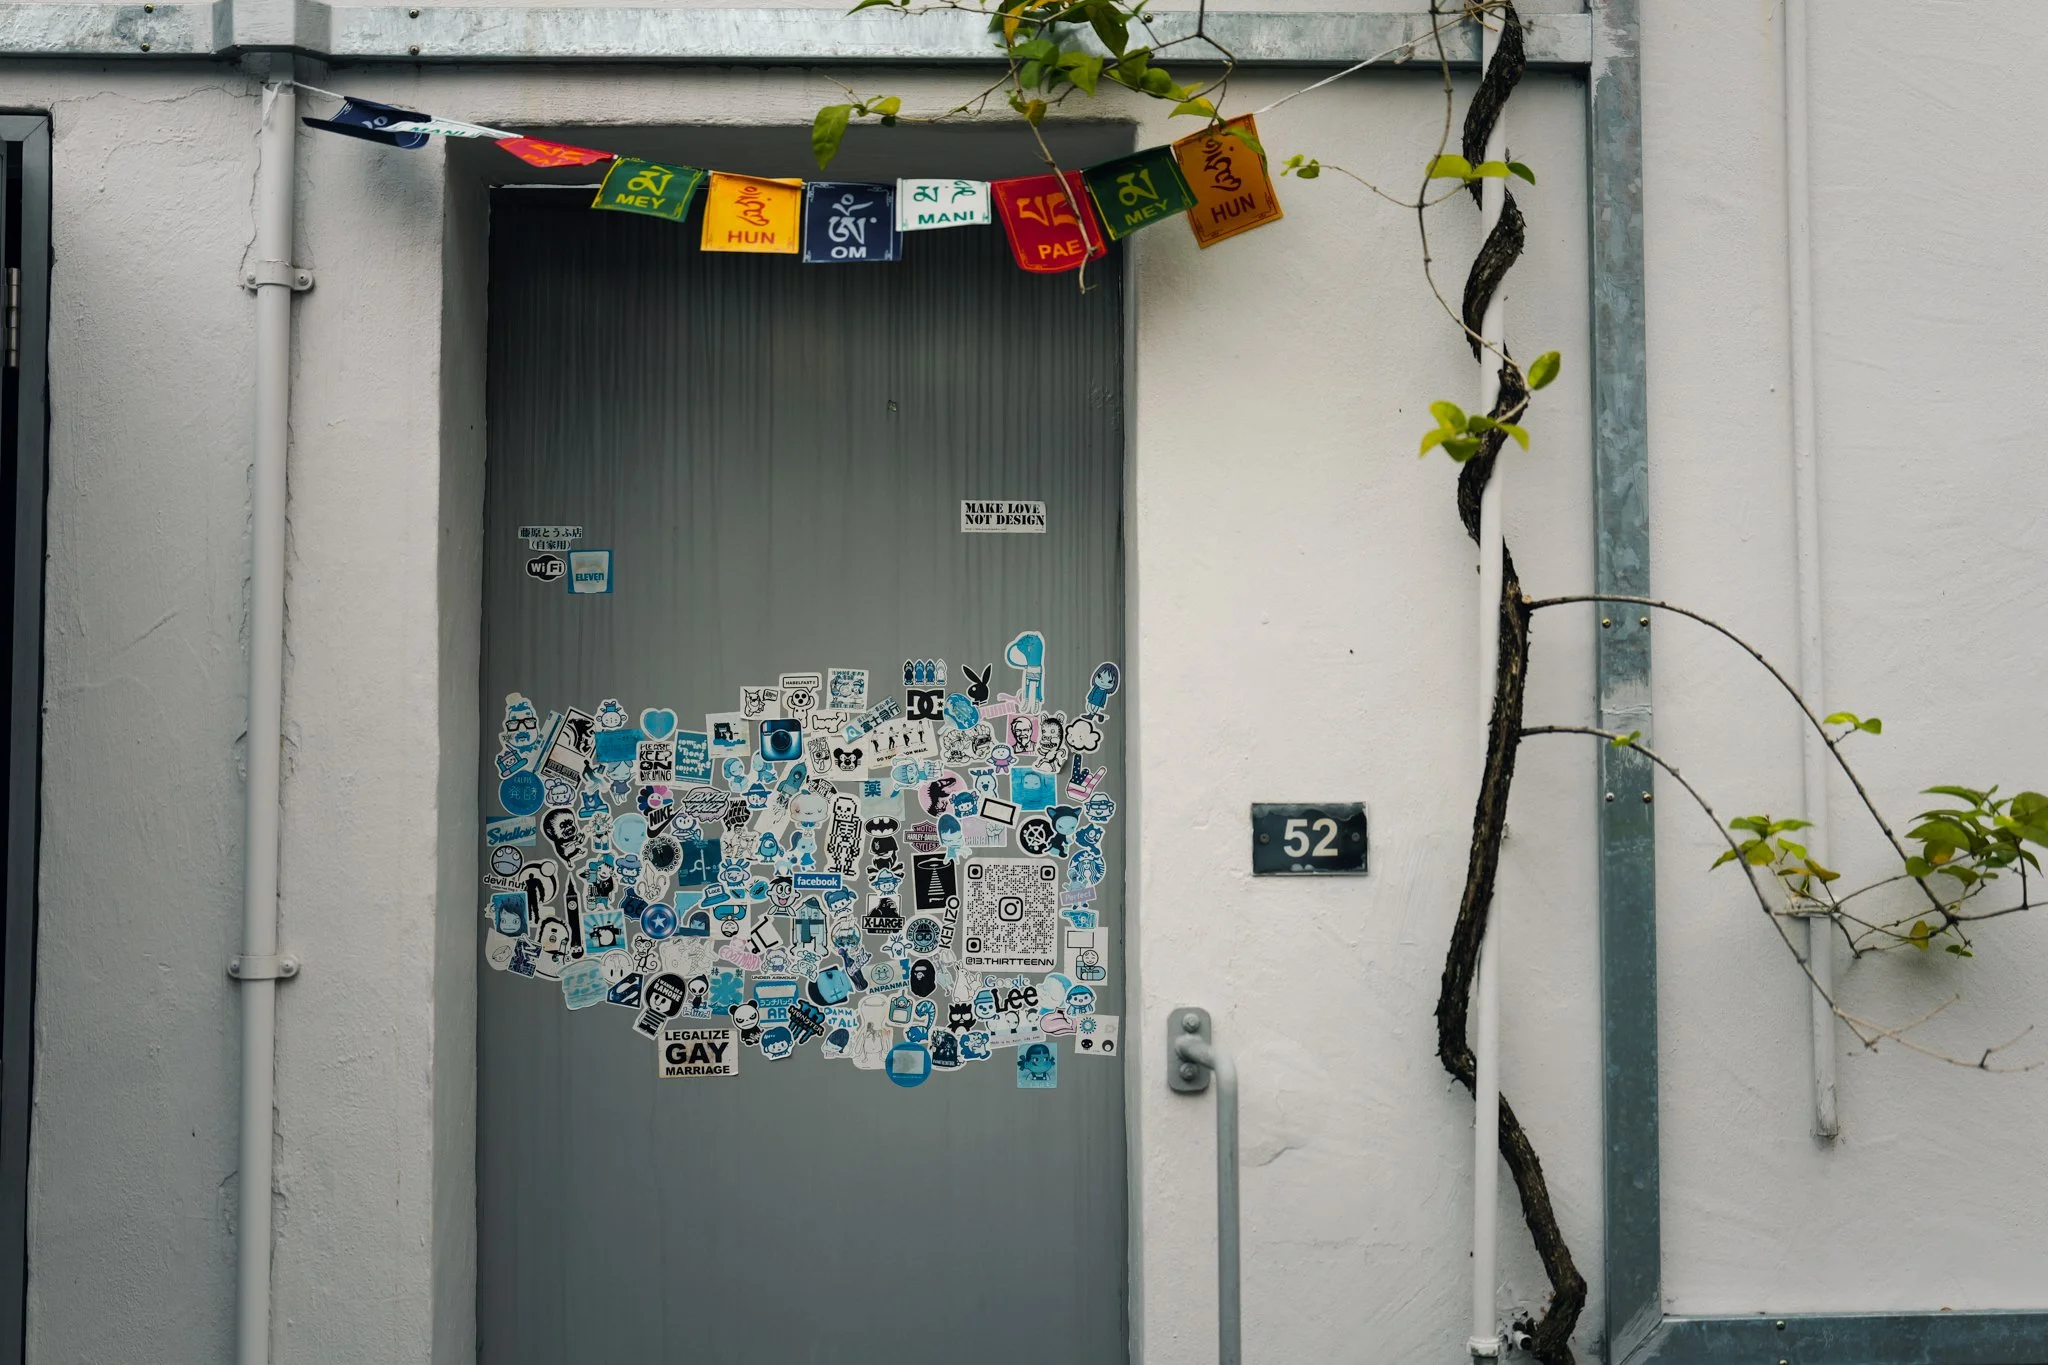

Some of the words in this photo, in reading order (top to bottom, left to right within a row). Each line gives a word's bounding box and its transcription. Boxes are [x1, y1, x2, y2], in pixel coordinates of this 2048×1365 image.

[615, 192, 667, 211] MEY
[1211, 193, 1256, 224] HUN
[918, 210, 974, 225] MANI
[1124, 199, 1169, 226] MEY
[728, 231, 775, 245] HUN
[831, 246, 867, 259] OM
[1038, 239, 1082, 260] PAE
[965, 502, 1004, 513] MAKE
[1008, 503, 1040, 514] LOVE
[965, 514, 992, 525] NOT
[996, 514, 1044, 526] DESIGN
[640, 743, 671, 751] PLEASE
[639, 750, 672, 761] KEEP
[640, 761, 672, 770] ON
[640, 770, 672, 782] DREAMING
[649, 804, 673, 827] NIKE
[487, 825, 537, 846] Swallows
[1284, 818, 1338, 858] 52
[484, 875, 506, 887] devil
[508, 880, 525, 890] nut
[797, 876, 838, 886] facebook
[939, 896, 961, 949] KENZO
[965, 956, 1055, 967] @13.THIRTTEENN
[659, 980, 675, 991] WANNA
[984, 974, 1031, 989] Google
[653, 982, 682, 1003] RAMONE
[991, 986, 1039, 1013] Lee
[788, 1007, 824, 1036] MONSTER
[665, 1030, 729, 1041] LEGALIZE
[665, 1042, 729, 1065] GAY
[665, 1066, 730, 1076] MARRIAGE
